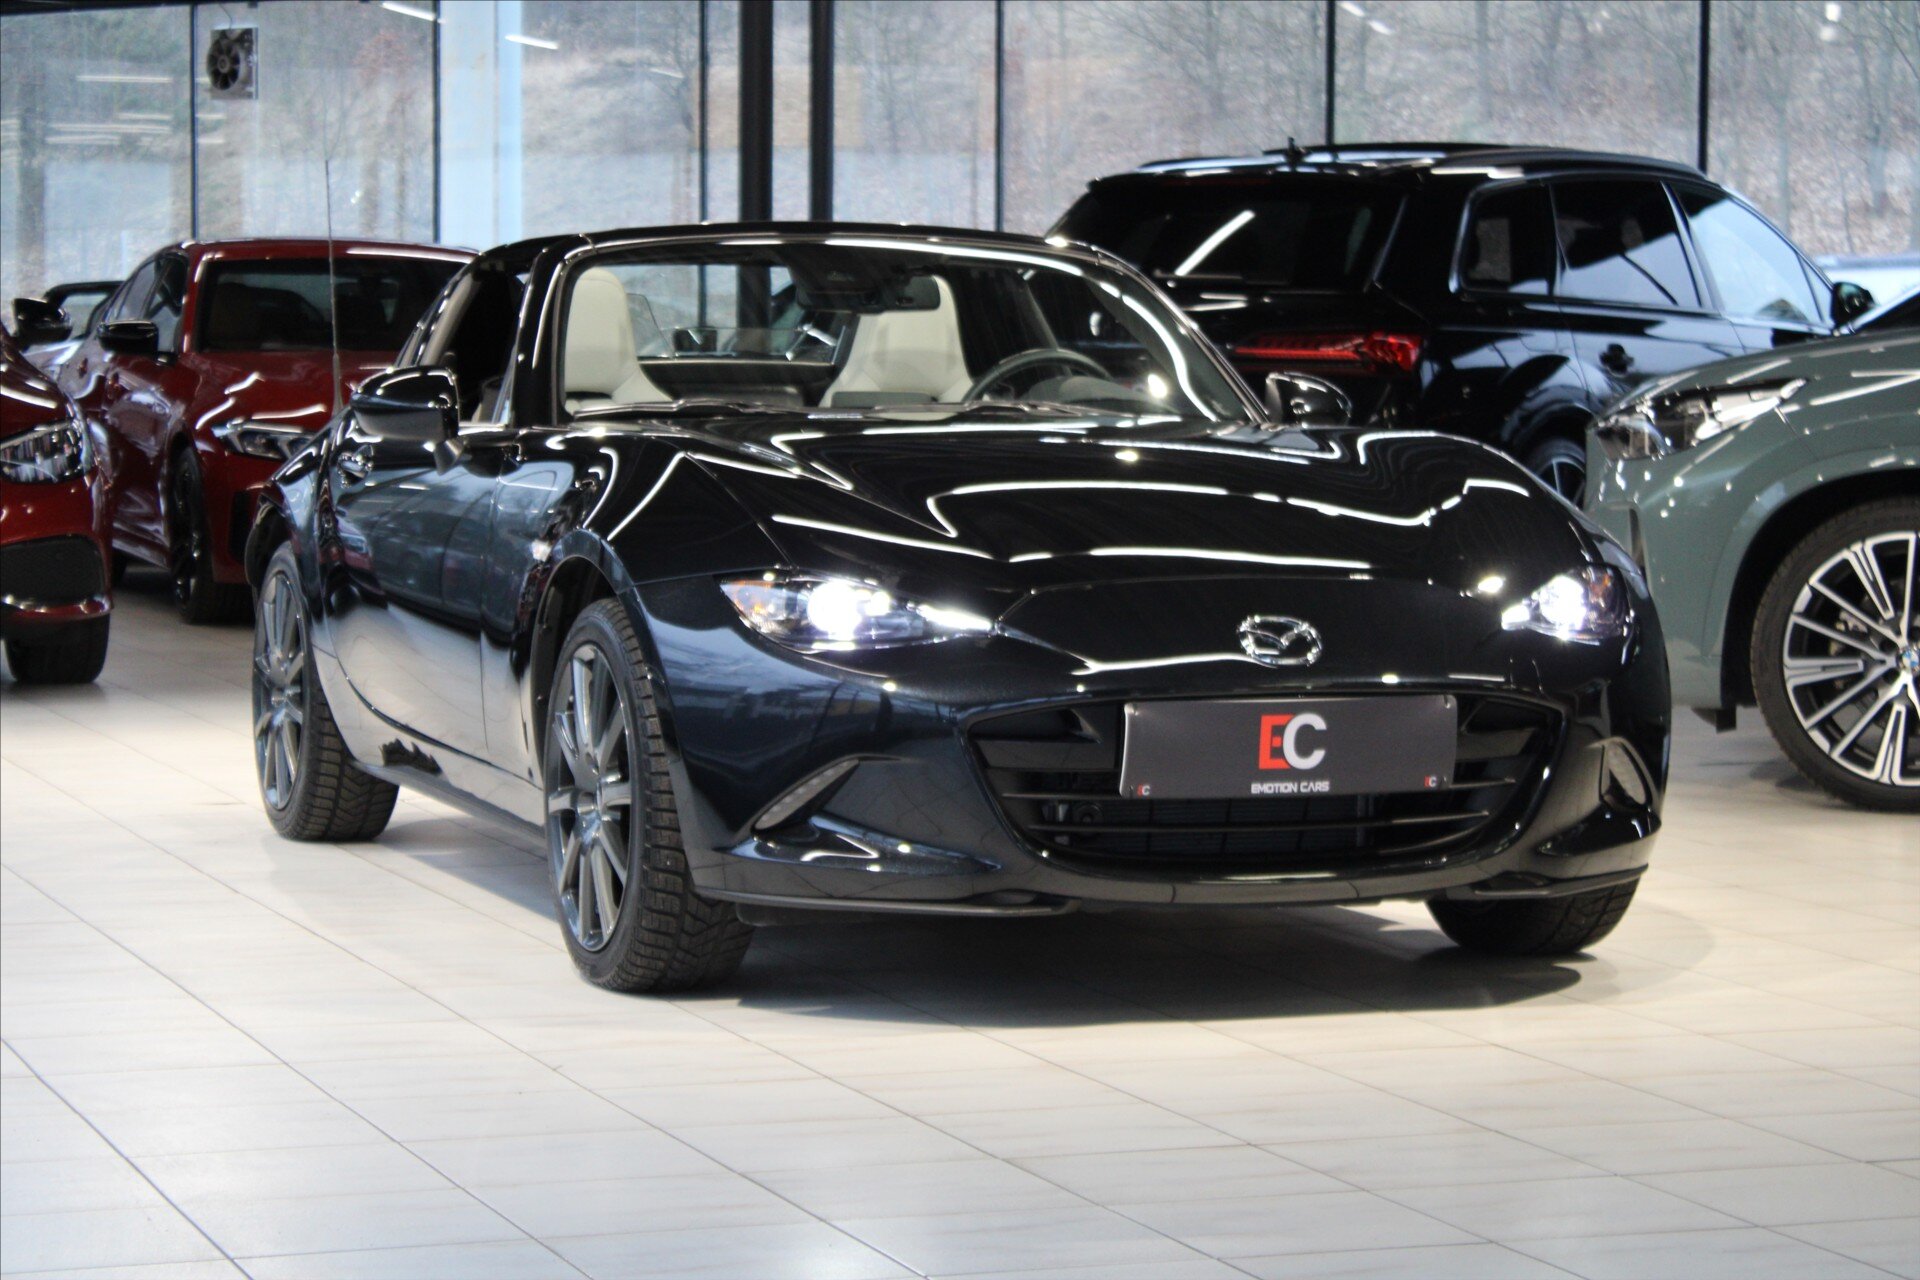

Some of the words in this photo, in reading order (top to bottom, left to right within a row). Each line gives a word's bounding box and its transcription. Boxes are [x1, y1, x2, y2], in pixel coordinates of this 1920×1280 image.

[1258, 712, 1328, 770] EC
[1251, 782, 1297, 794] EMOTION
[1300, 781, 1330, 792] CARS
